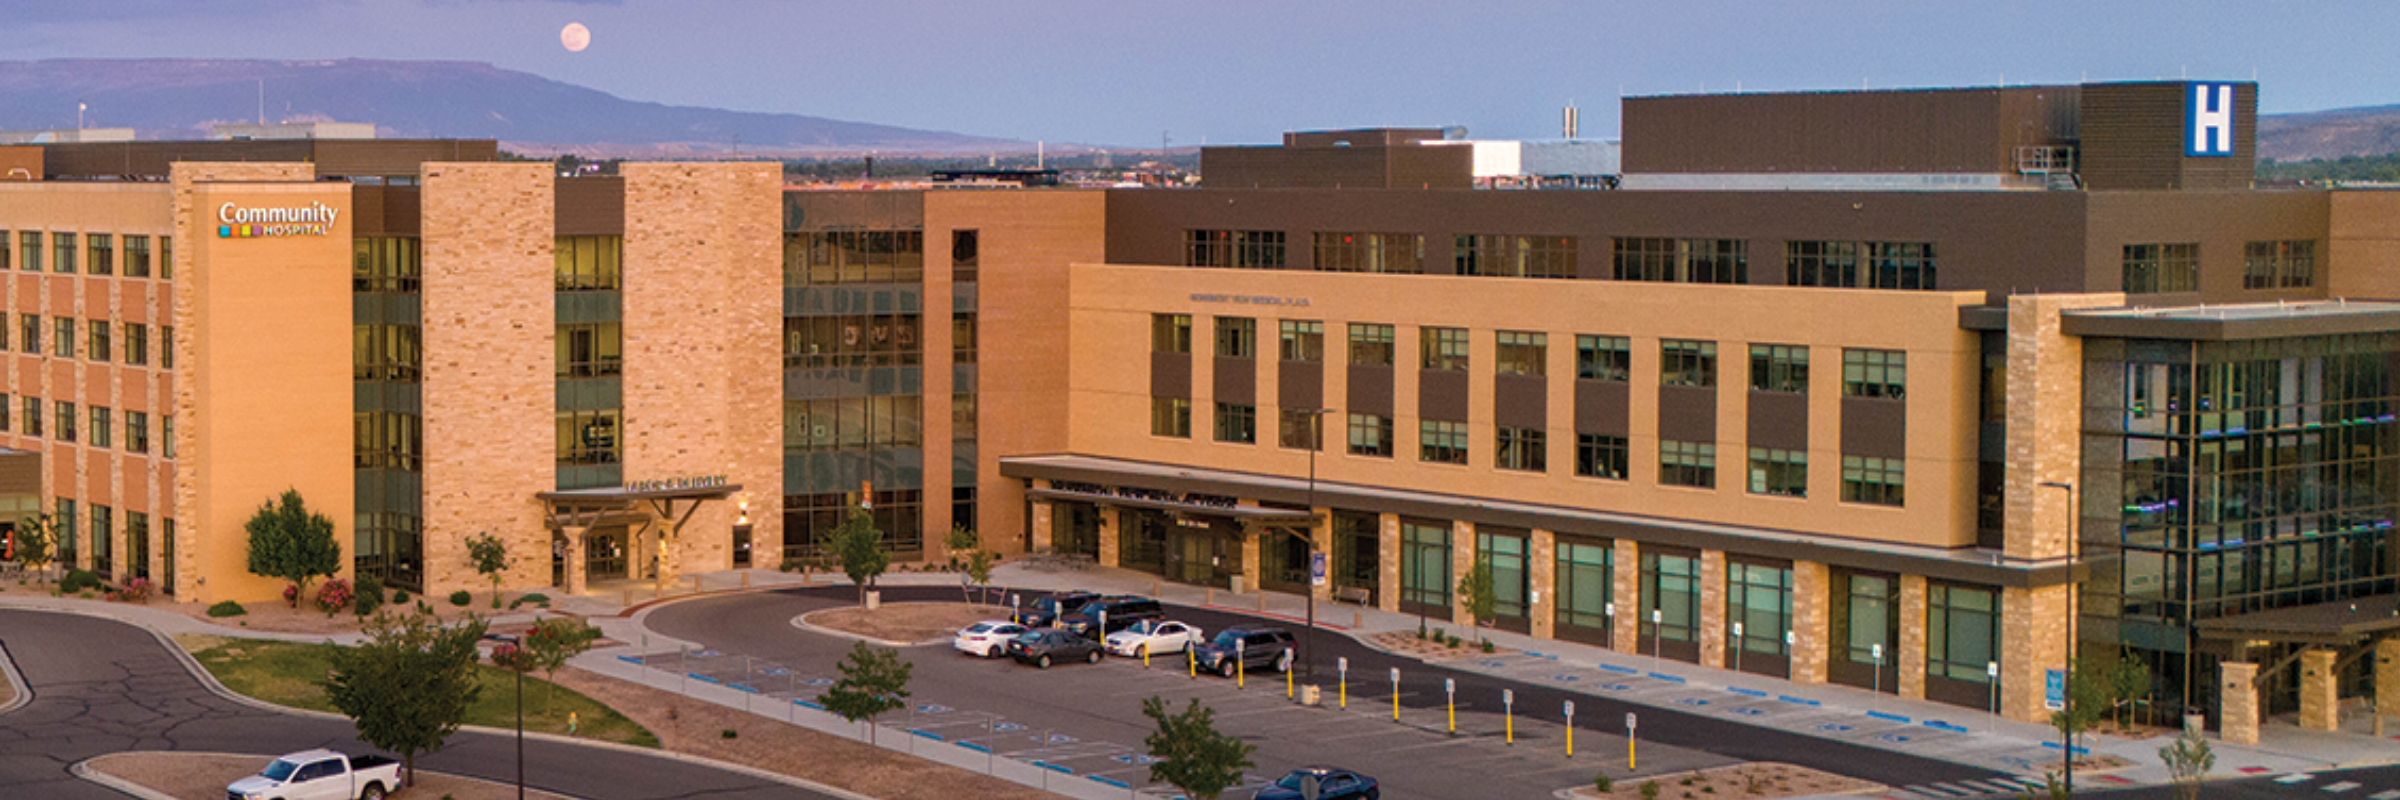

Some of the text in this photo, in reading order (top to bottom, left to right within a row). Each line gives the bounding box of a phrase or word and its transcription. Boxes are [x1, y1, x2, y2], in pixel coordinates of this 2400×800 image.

[2195, 84, 2231, 152] H
[219, 201, 338, 229] Community
[263, 224, 327, 236] HOSPITAL
